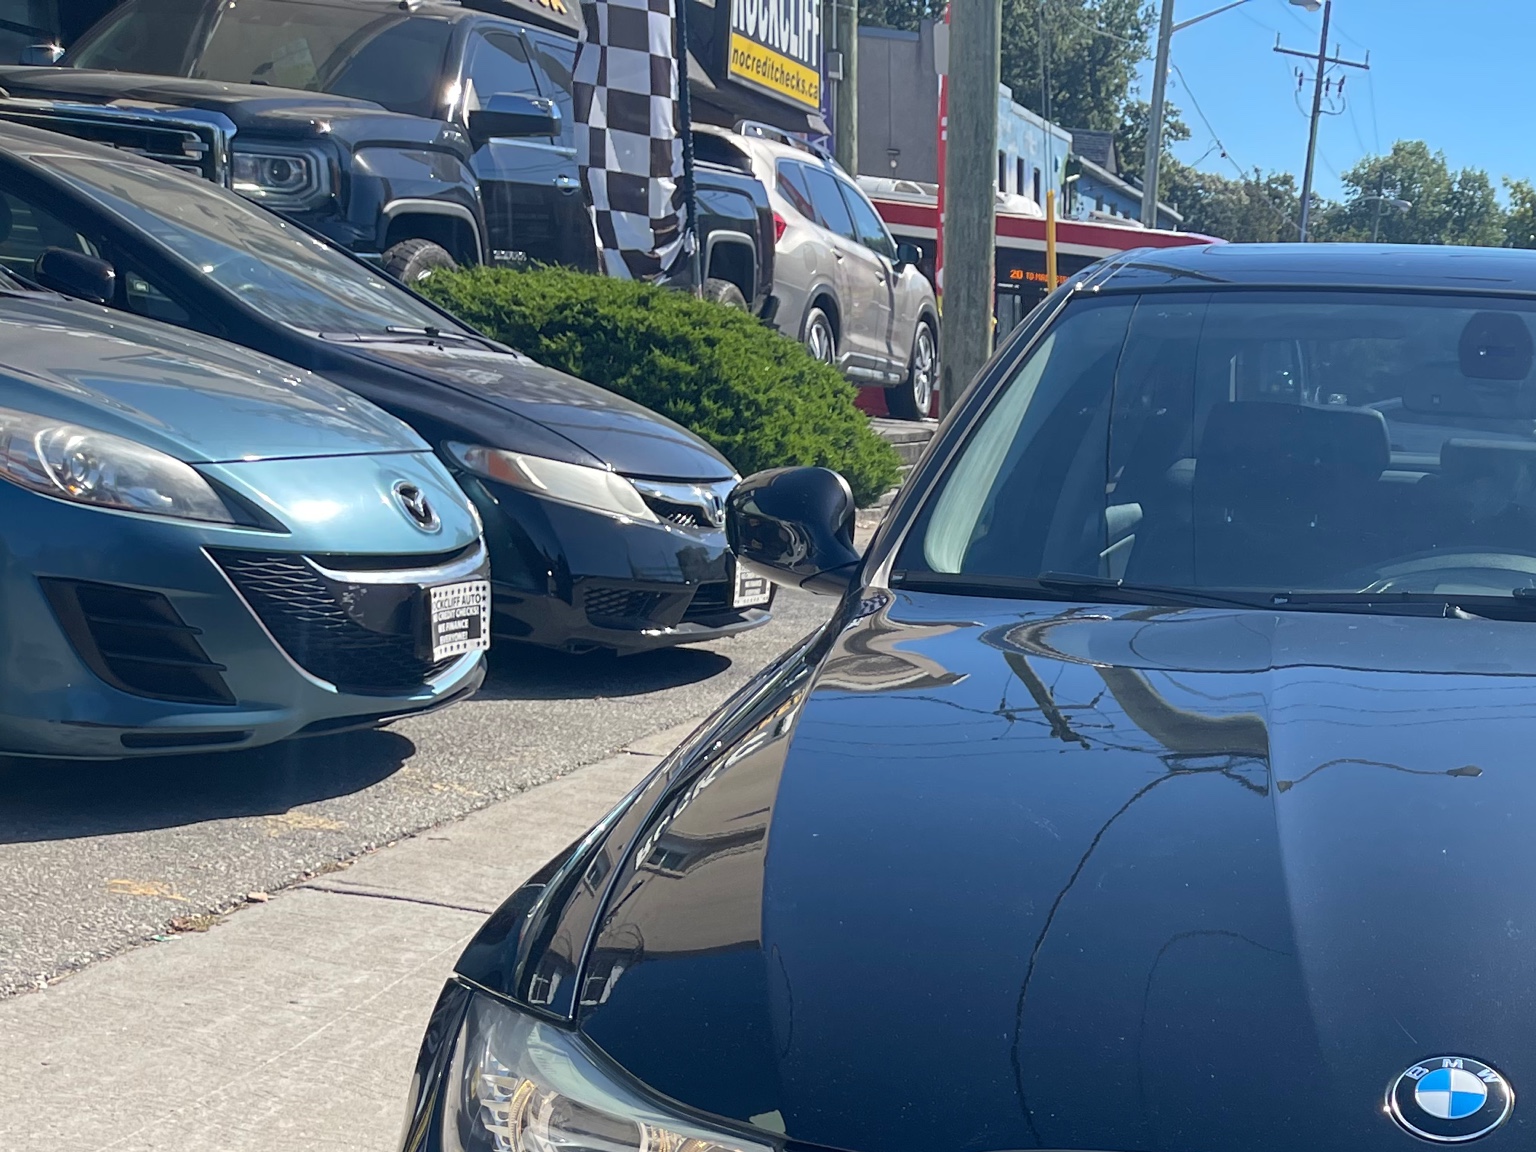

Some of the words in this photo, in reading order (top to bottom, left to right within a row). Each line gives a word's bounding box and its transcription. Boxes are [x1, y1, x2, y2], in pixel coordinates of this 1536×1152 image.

[732, 47, 818, 100] nocreditchecks.ca
[1009, 269, 1024, 280] 20
[461, 594, 481, 605] AUTO
[1406, 1058, 1502, 1084] BMW
